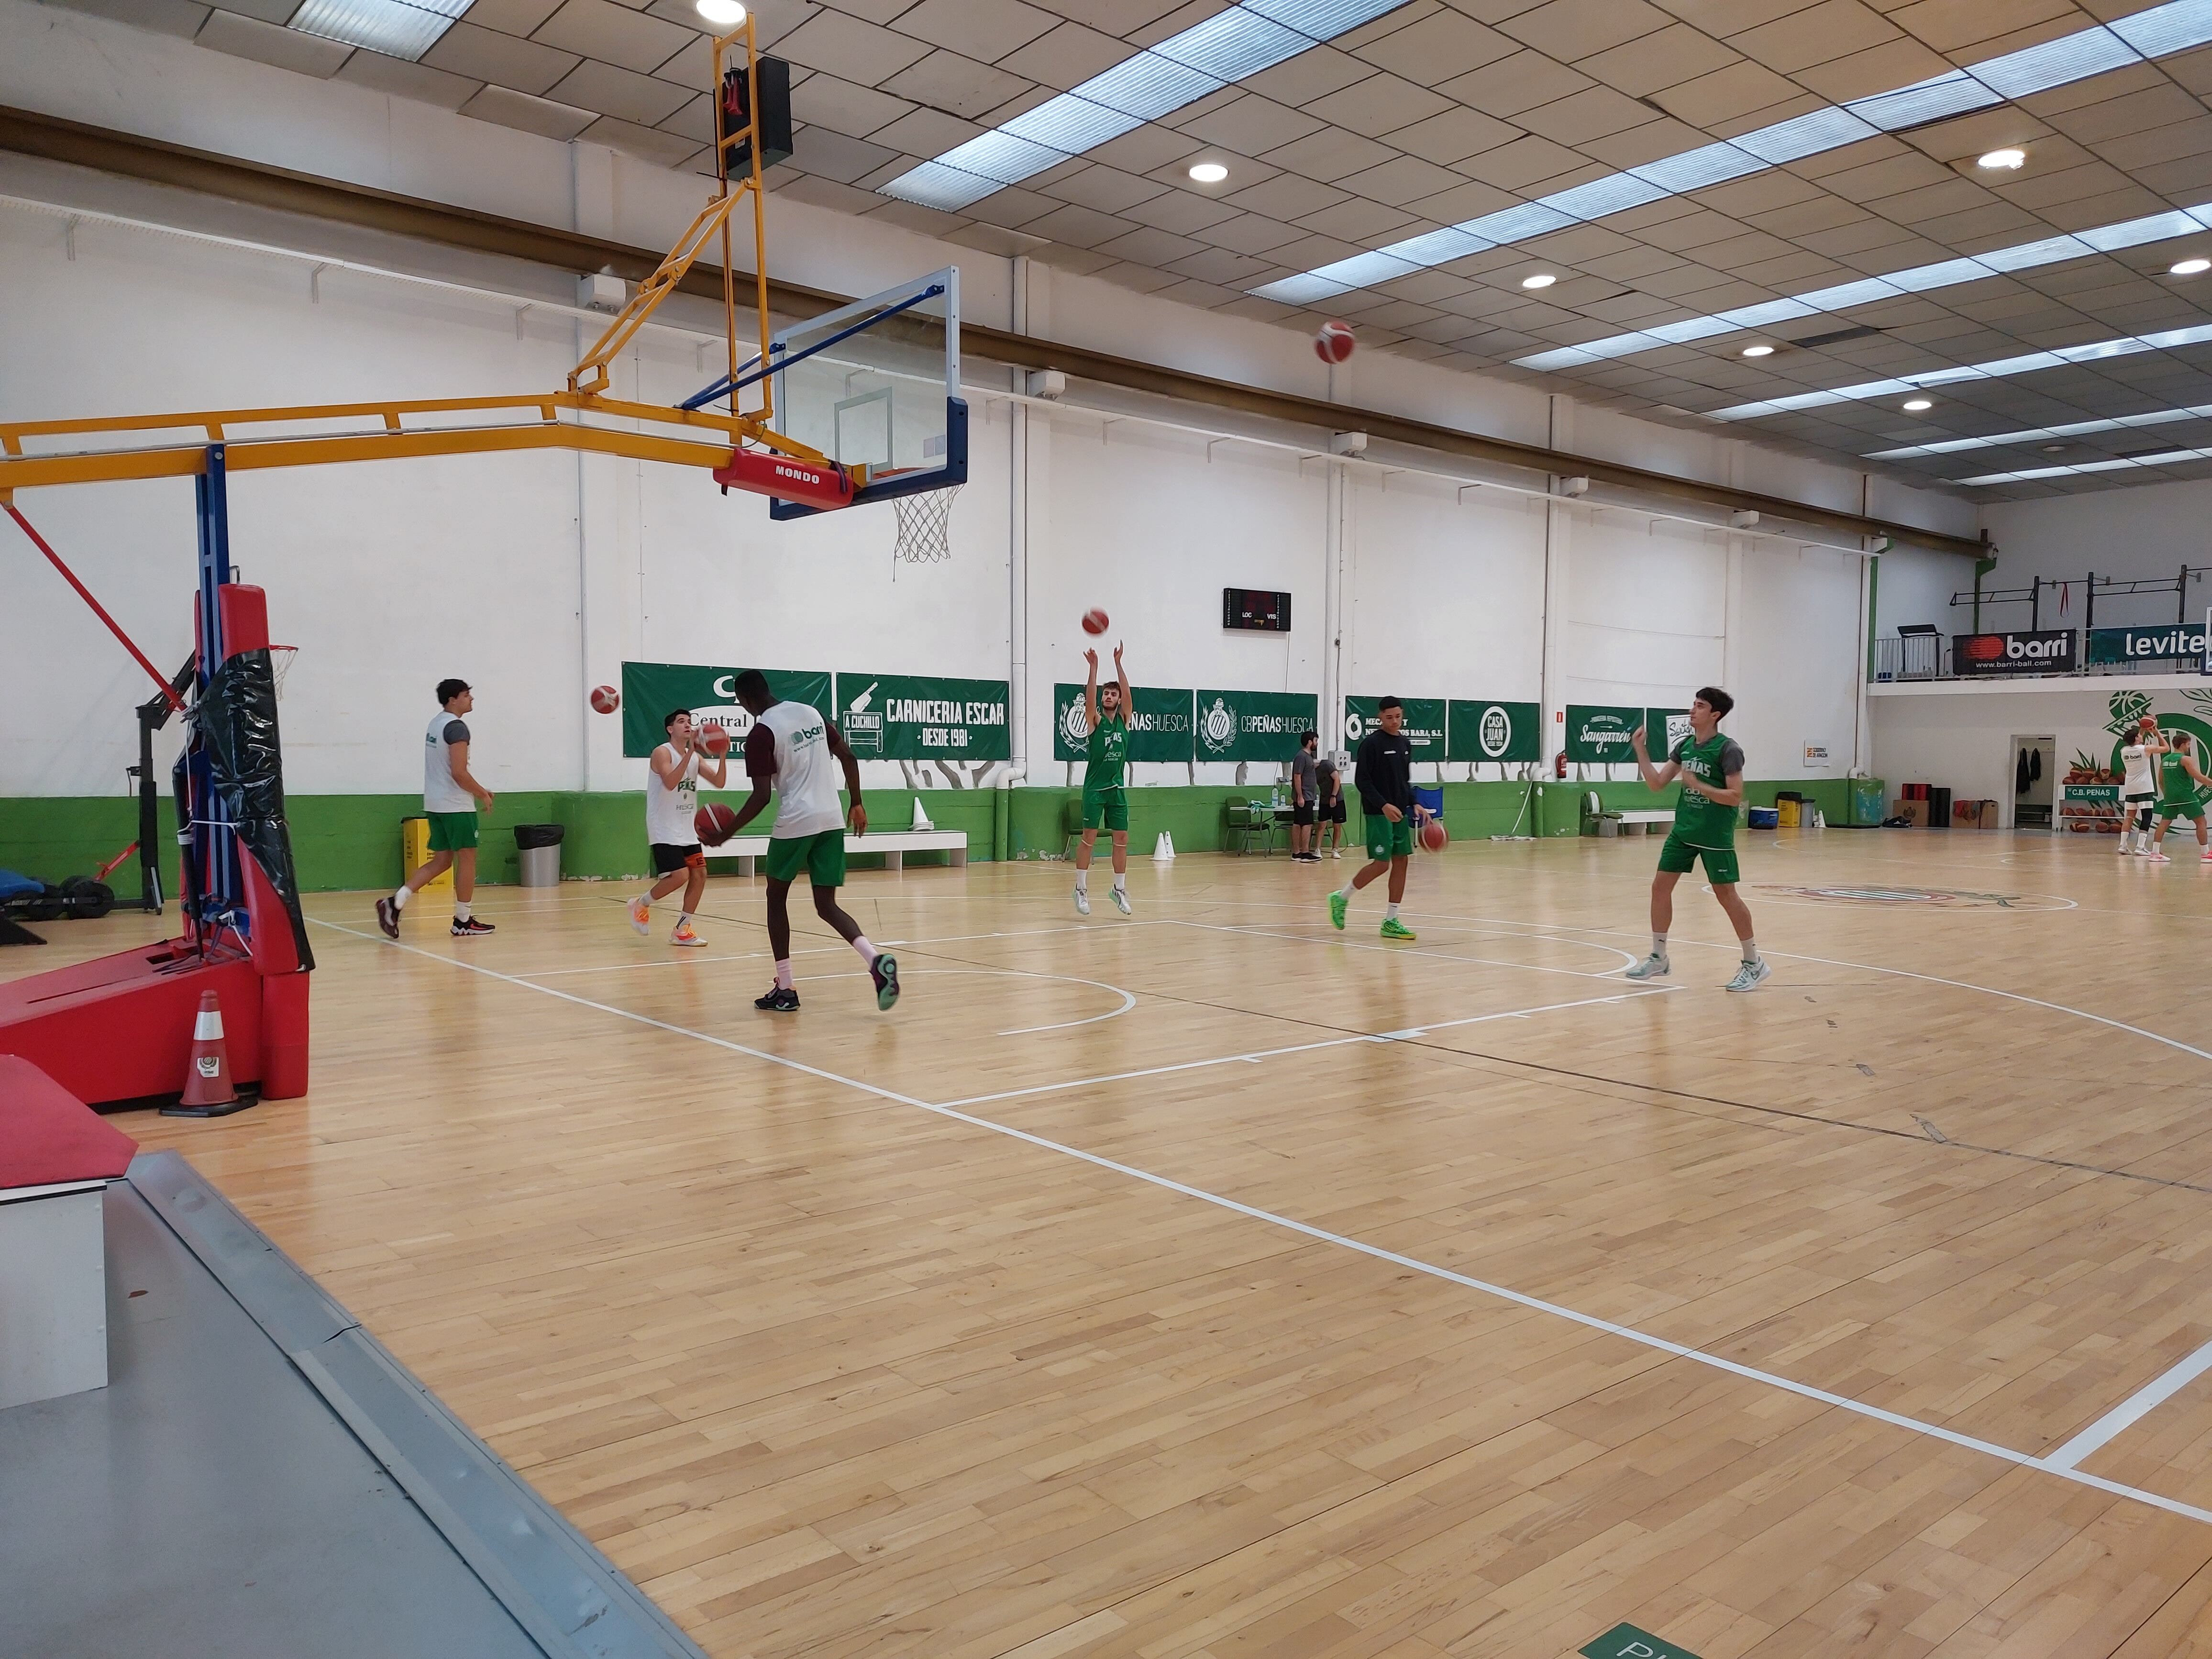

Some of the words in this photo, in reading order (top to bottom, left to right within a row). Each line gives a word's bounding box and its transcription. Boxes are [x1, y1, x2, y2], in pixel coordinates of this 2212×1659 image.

[776, 465, 819, 484] MONDO
[2006, 632, 2068, 659] barri
[2125, 630, 2205, 656] levite
[1976, 660, 2052, 668] www.barri-ball.com
[690, 713, 748, 728] Central
[886, 699, 962, 724] CARNICERIA
[966, 702, 1004, 725] ESCAR
[845, 716, 850, 728] A
[852, 715, 879, 729] CUCHILLO
[1487, 716, 1503, 728] CASA
[922, 728, 949, 746] DESDE
[951, 729, 968, 747] 1981
[1486, 728, 1504, 741] JUAN
